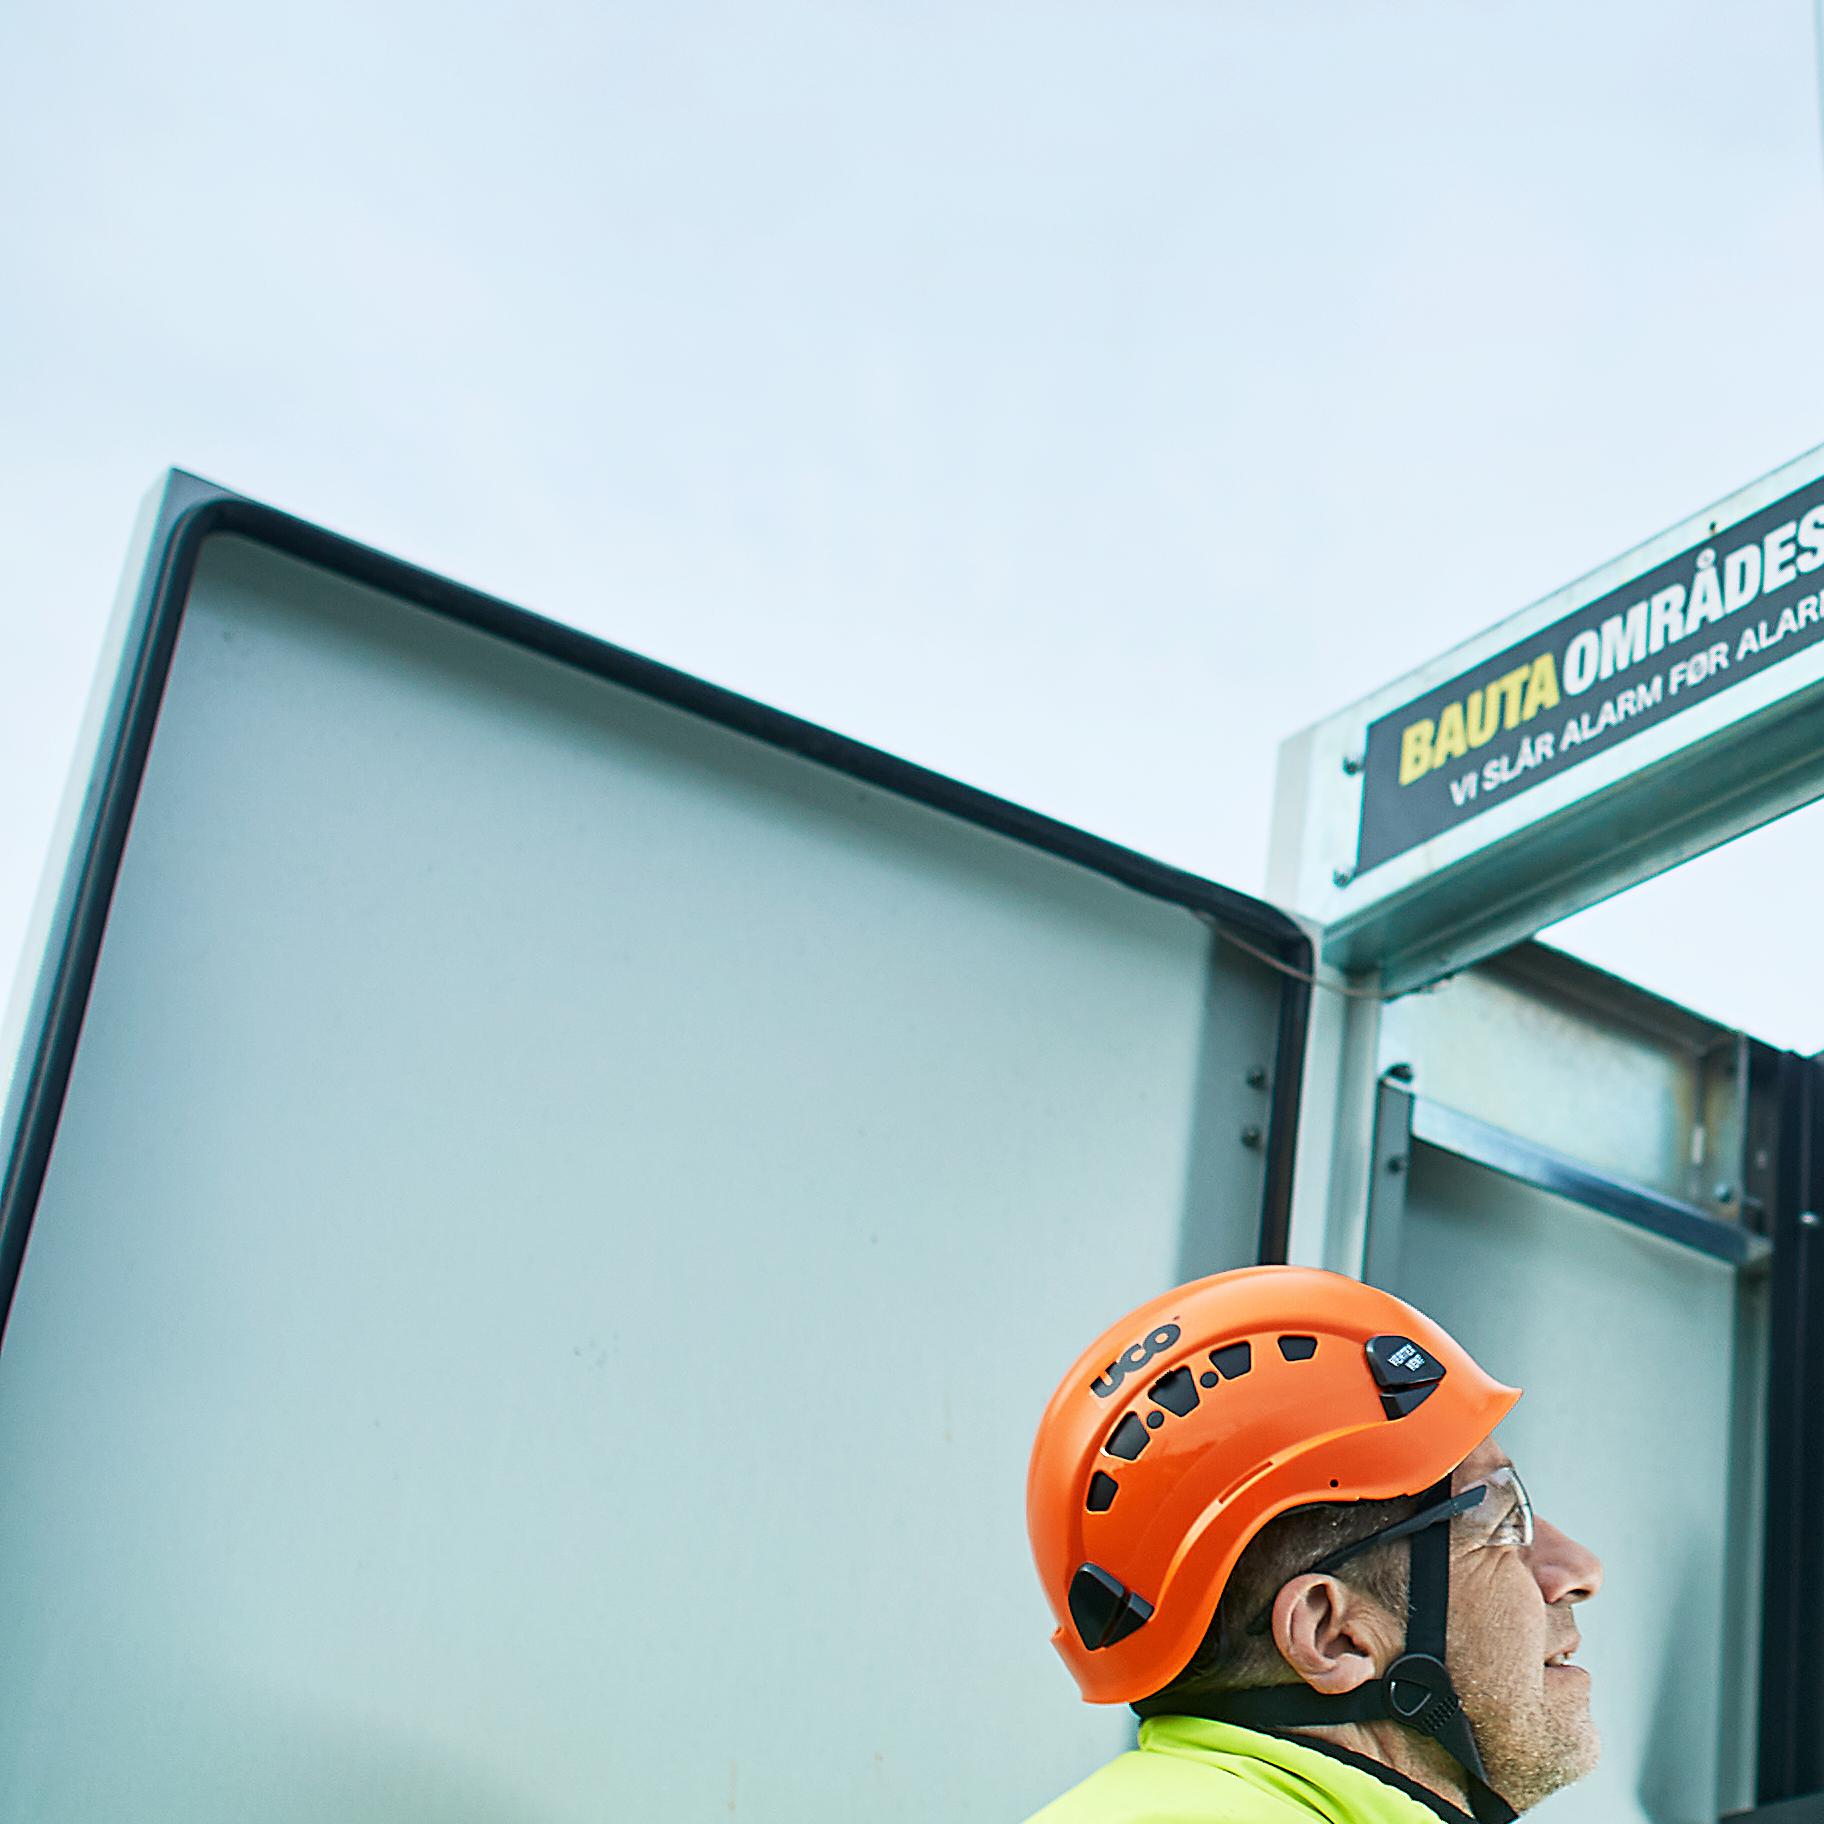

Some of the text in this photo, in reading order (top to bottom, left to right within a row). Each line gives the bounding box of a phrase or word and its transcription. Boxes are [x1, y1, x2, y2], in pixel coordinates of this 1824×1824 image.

[1450, 772, 1479, 806] VI
[1482, 731, 1555, 791] SLÅR
[1559, 675, 1663, 752] ALARM
[1668, 642, 1729, 695] FØR
